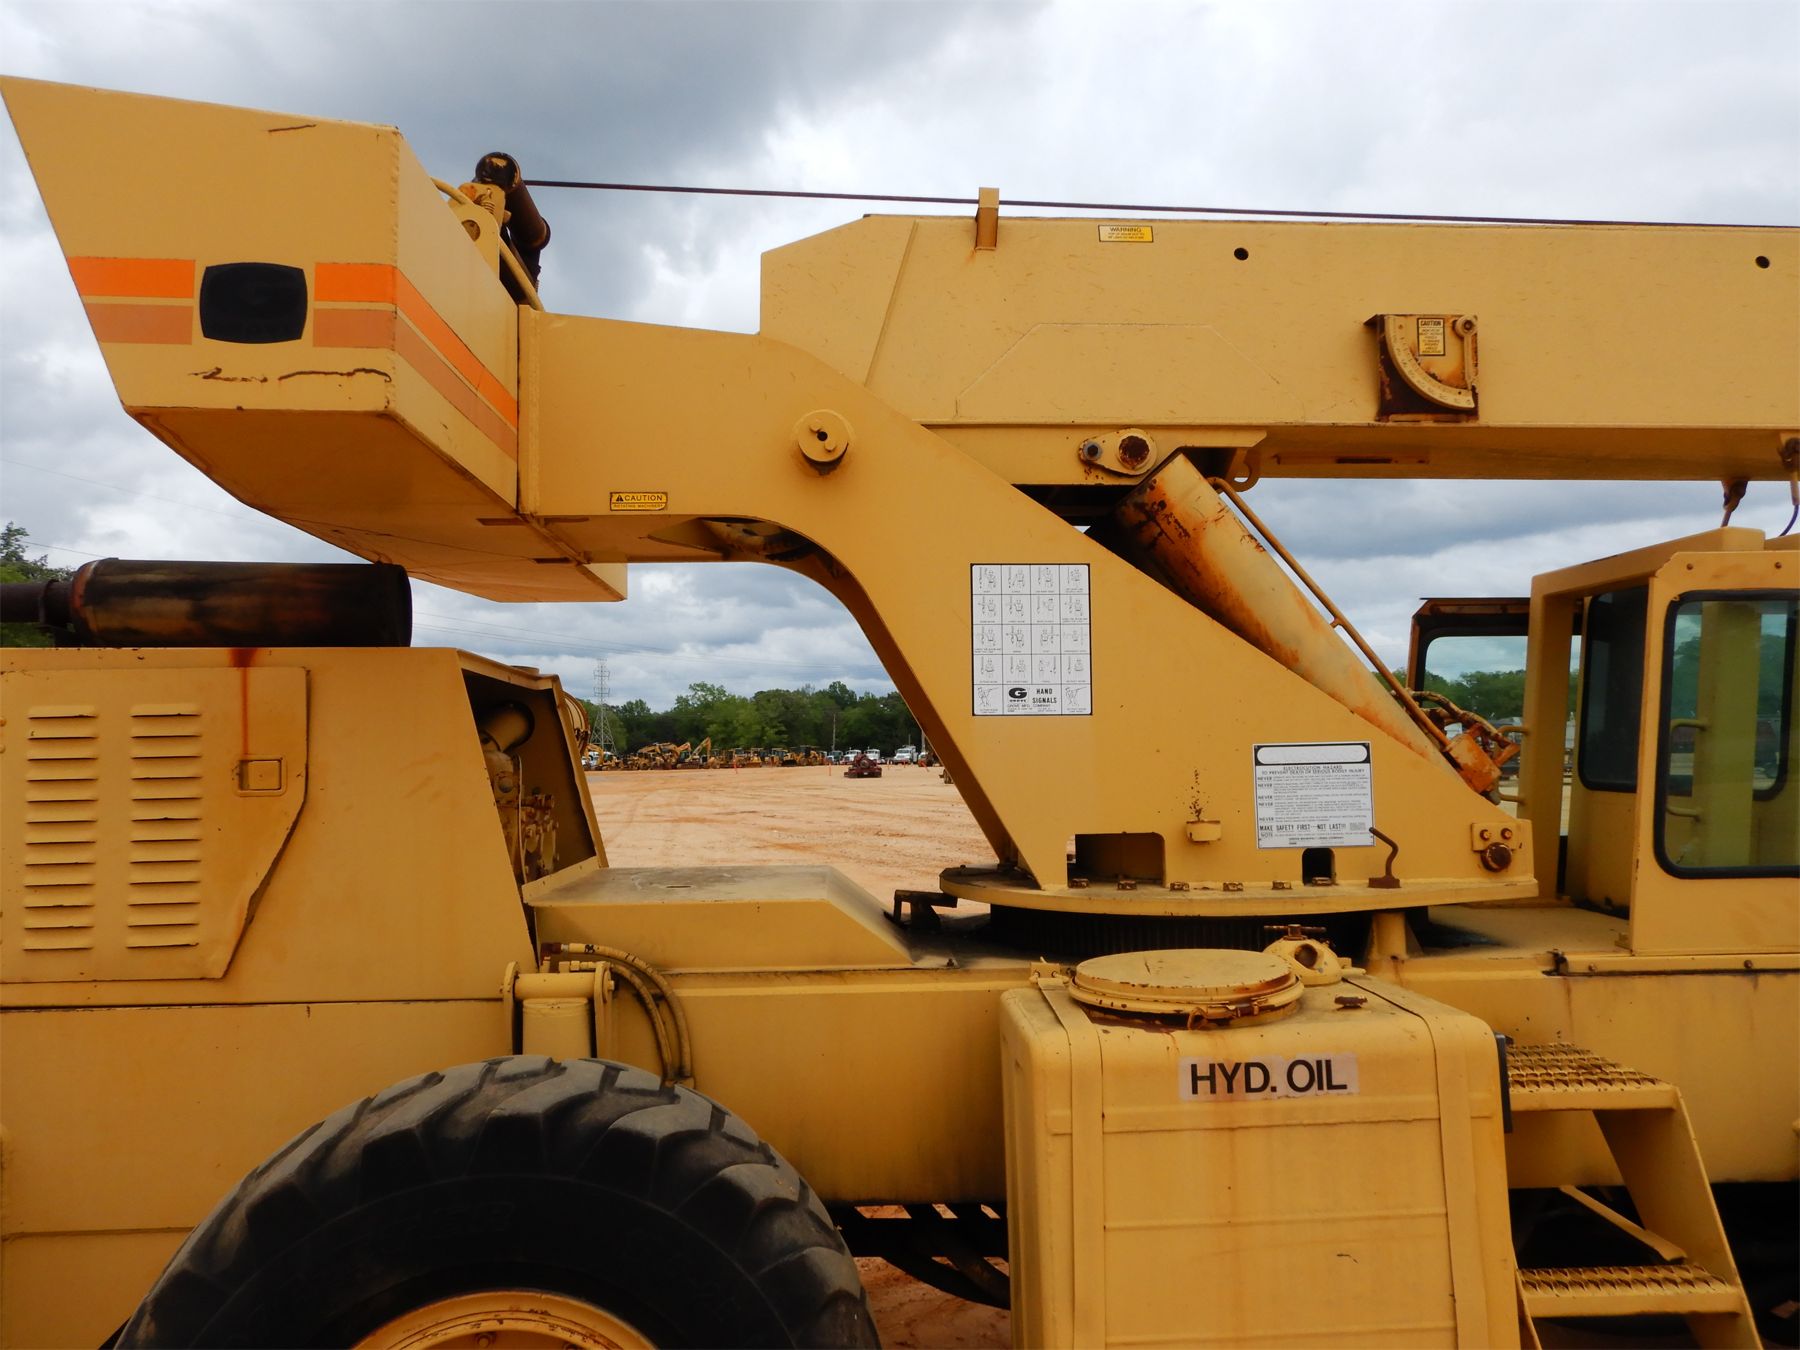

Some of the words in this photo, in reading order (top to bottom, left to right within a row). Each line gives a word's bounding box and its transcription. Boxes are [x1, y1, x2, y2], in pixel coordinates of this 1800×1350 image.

[1008, 687, 1027, 699] G
[1191, 1062, 1277, 1094] HYD.
[1287, 1059, 1347, 1092] OIL
